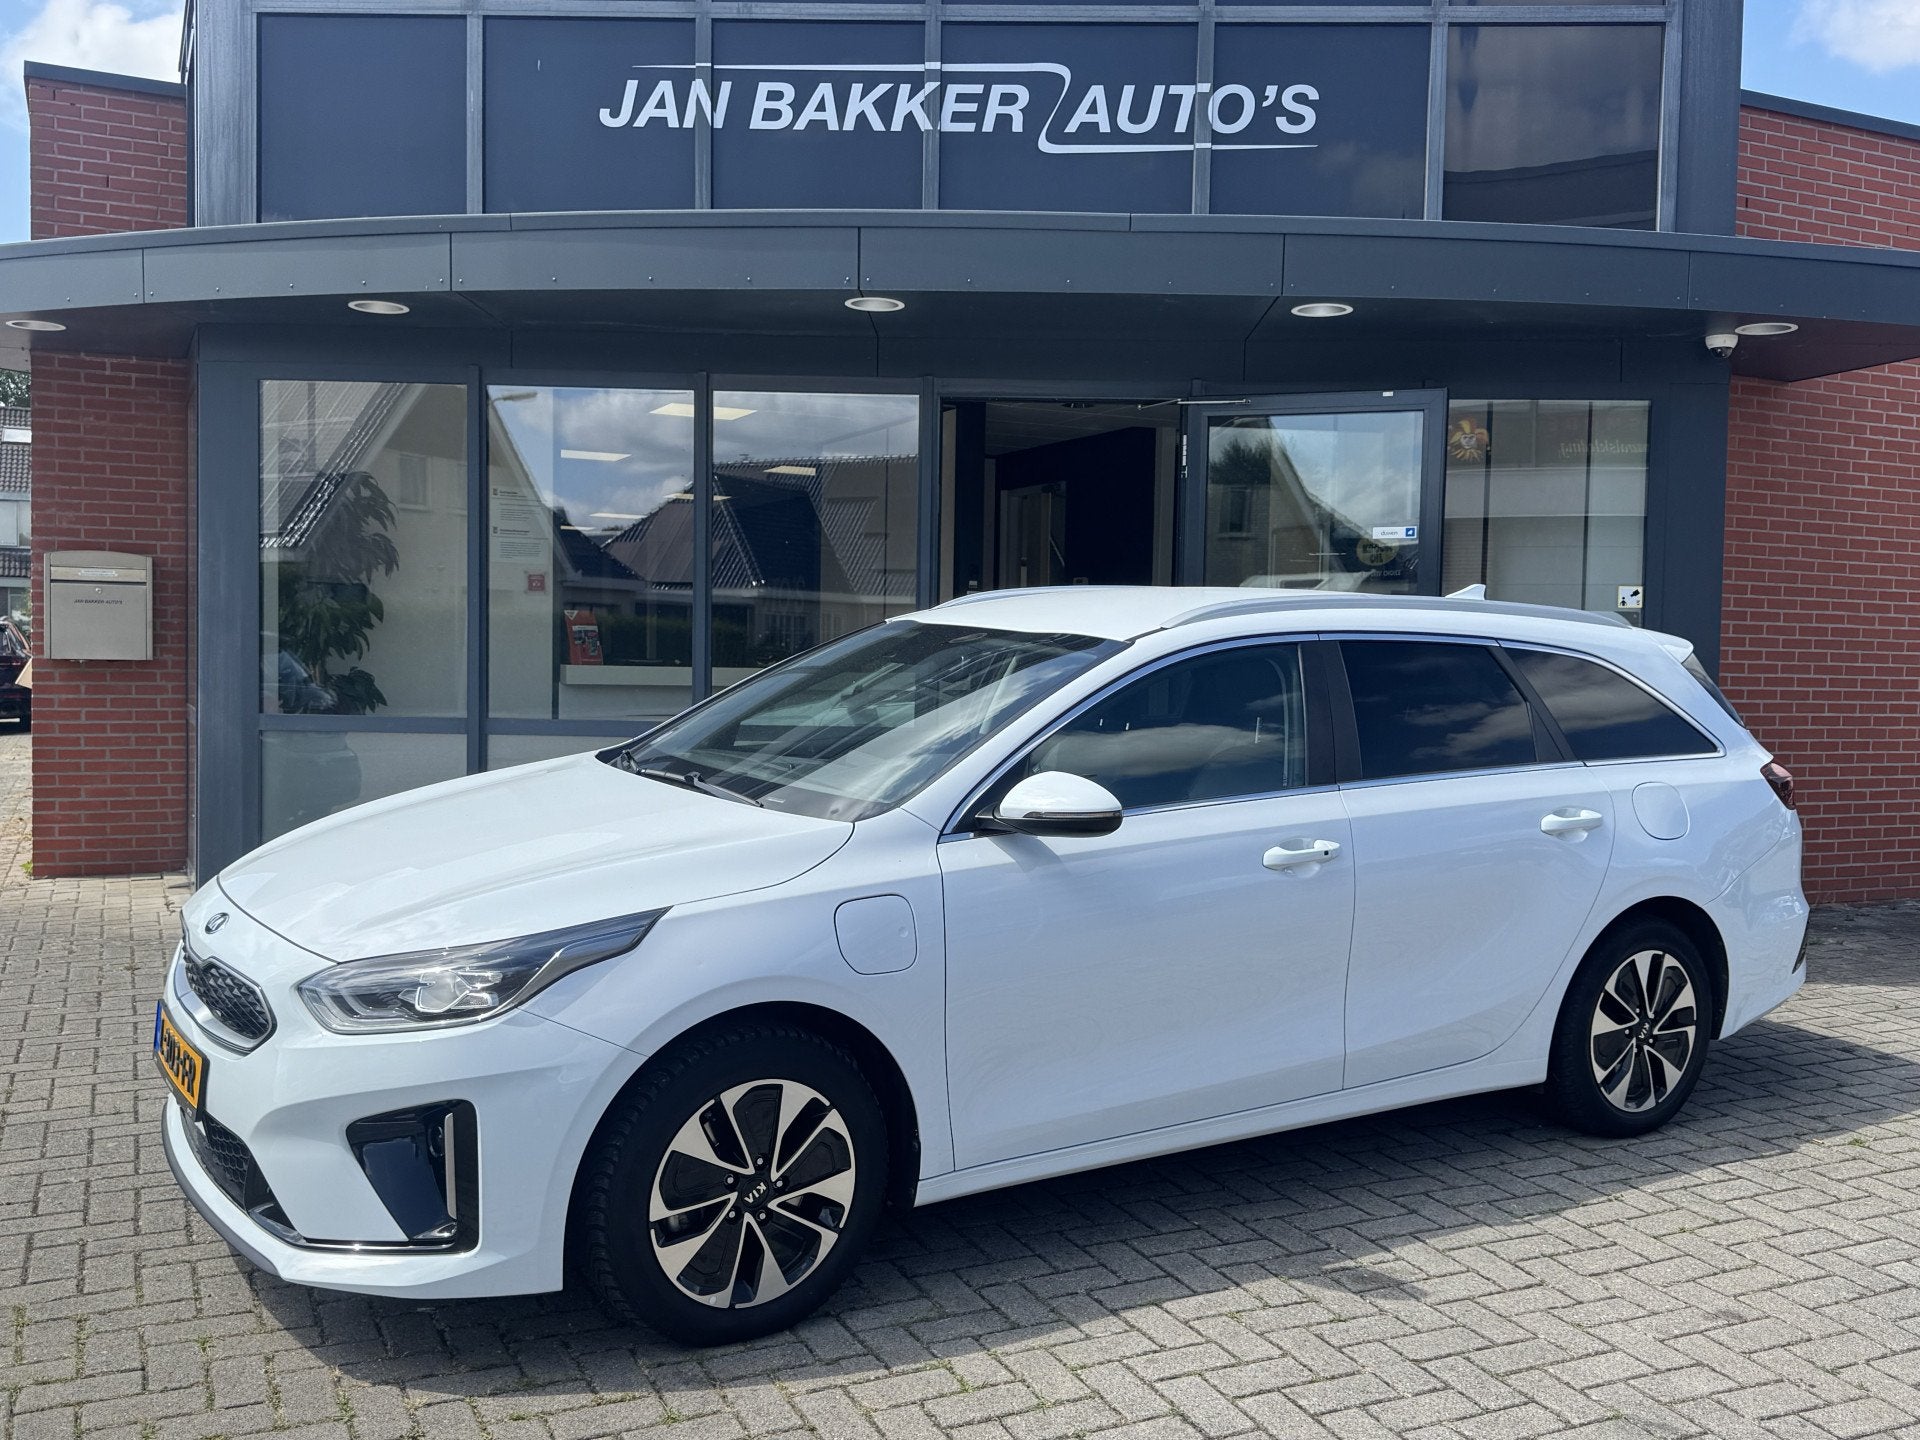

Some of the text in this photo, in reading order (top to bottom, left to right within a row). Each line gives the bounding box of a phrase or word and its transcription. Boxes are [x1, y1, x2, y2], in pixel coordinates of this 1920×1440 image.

[598, 79, 1320, 136] JAN BAKKER AUTO'S
[744, 1182, 767, 1203] KIA
